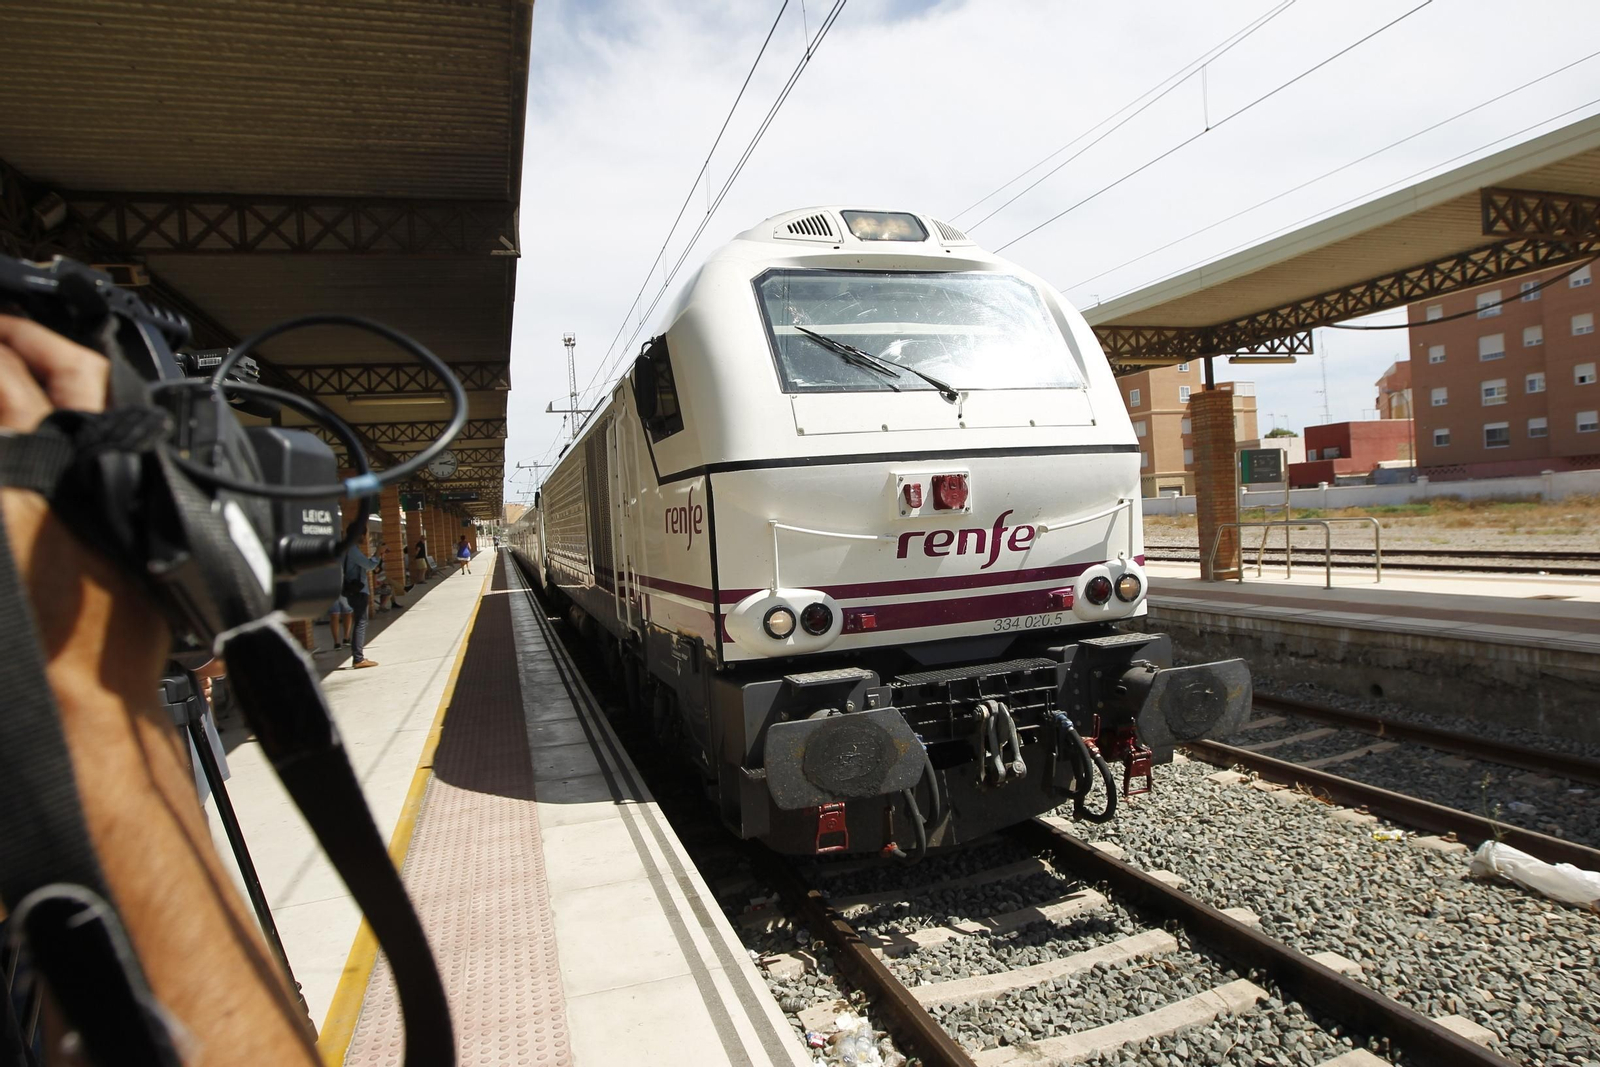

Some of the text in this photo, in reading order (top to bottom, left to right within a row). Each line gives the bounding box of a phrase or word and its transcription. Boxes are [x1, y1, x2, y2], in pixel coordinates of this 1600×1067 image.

[302, 509, 333, 524] LEICA
[665, 486, 703, 551] renfe
[897, 509, 1036, 570] renfe
